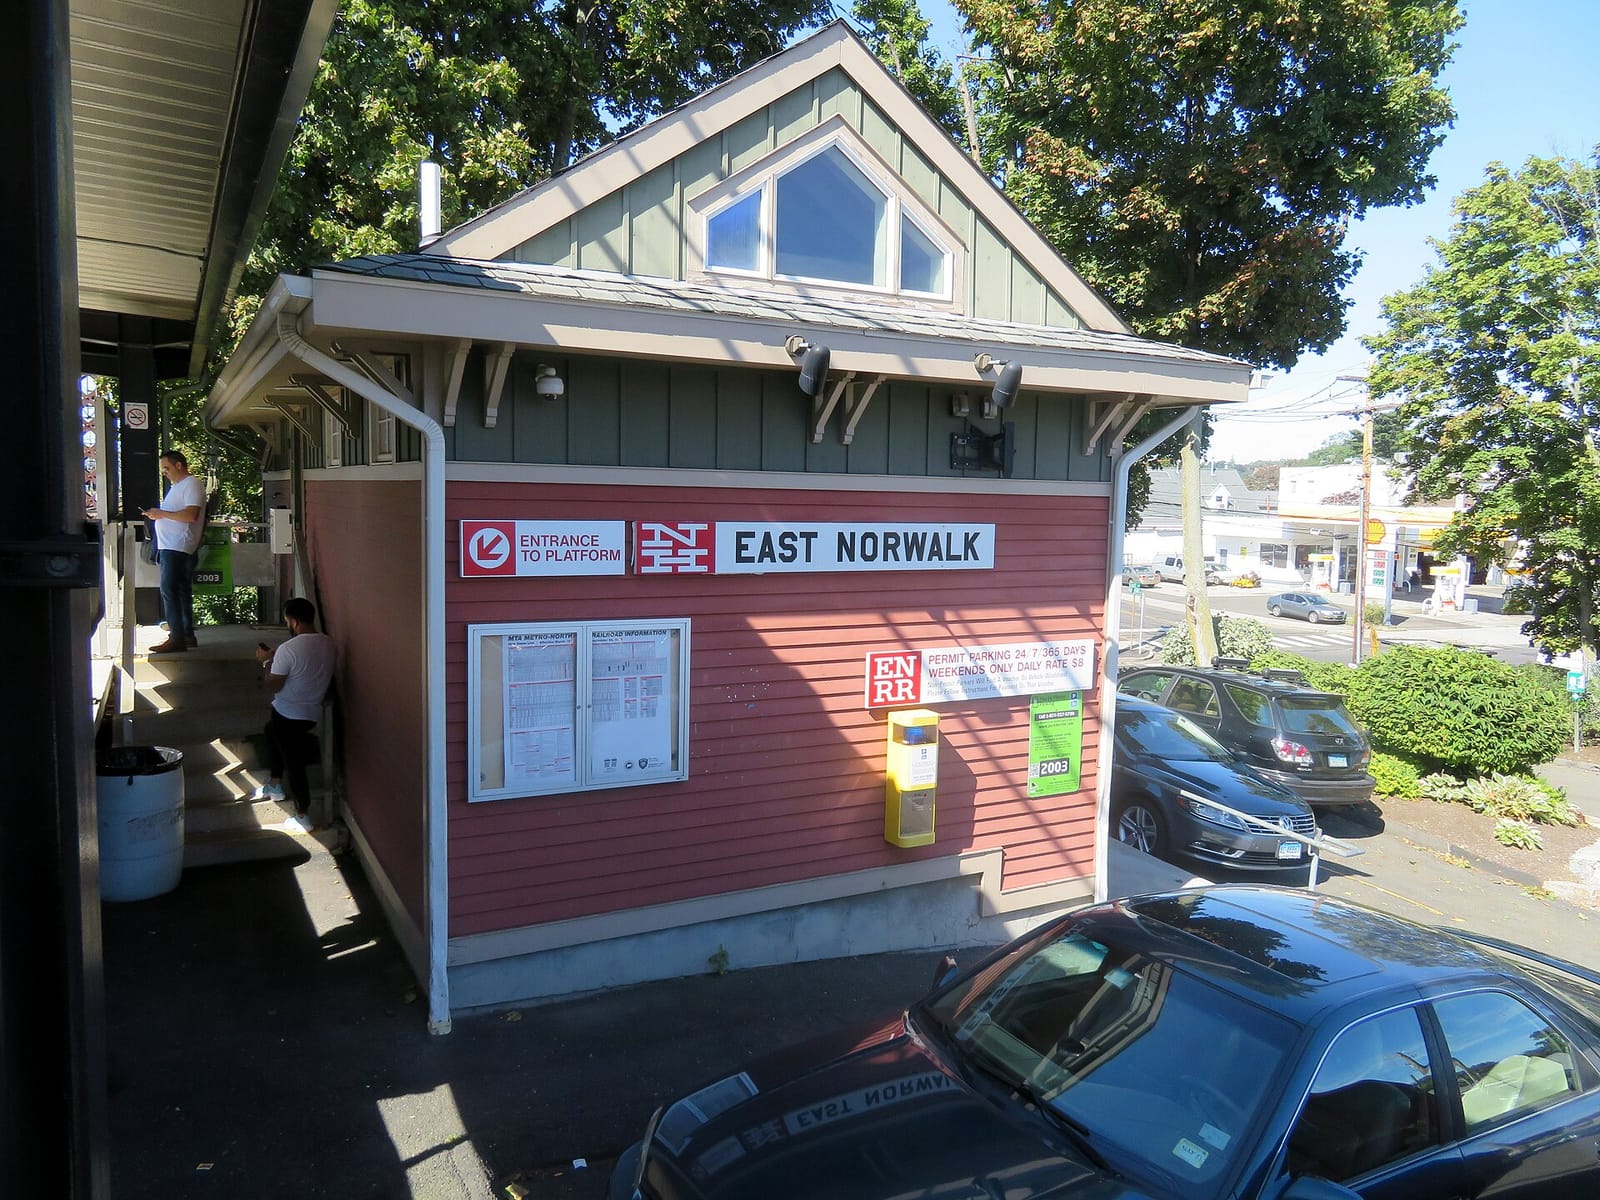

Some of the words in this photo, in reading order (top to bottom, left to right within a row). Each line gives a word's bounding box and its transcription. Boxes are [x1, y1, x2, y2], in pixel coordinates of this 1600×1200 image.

[520, 534, 600, 547] ENTRANCE
[735, 531, 818, 563] EAST
[837, 531, 981, 562] NORWALK
[521, 549, 541, 562] TO
[545, 549, 621, 561] PLATFORM
[196, 574, 220, 582] 2003
[508, 634, 522, 642] MTA
[624, 629, 667, 637] INFORMATION
[928, 653, 965, 665] PERMIT
[969, 649, 1011, 662] PARKING
[1063, 645, 1086, 656] DAYS
[873, 655, 917, 680] EN
[928, 664, 985, 678] WEEKENDS
[989, 663, 1014, 674] ONLY
[1017, 660, 1042, 672] DAILY
[1045, 659, 1068, 669] RATE
[1072, 657, 1084, 668] $8
[873, 678, 916, 703] RR
[1040, 760, 1068, 775] 2003
